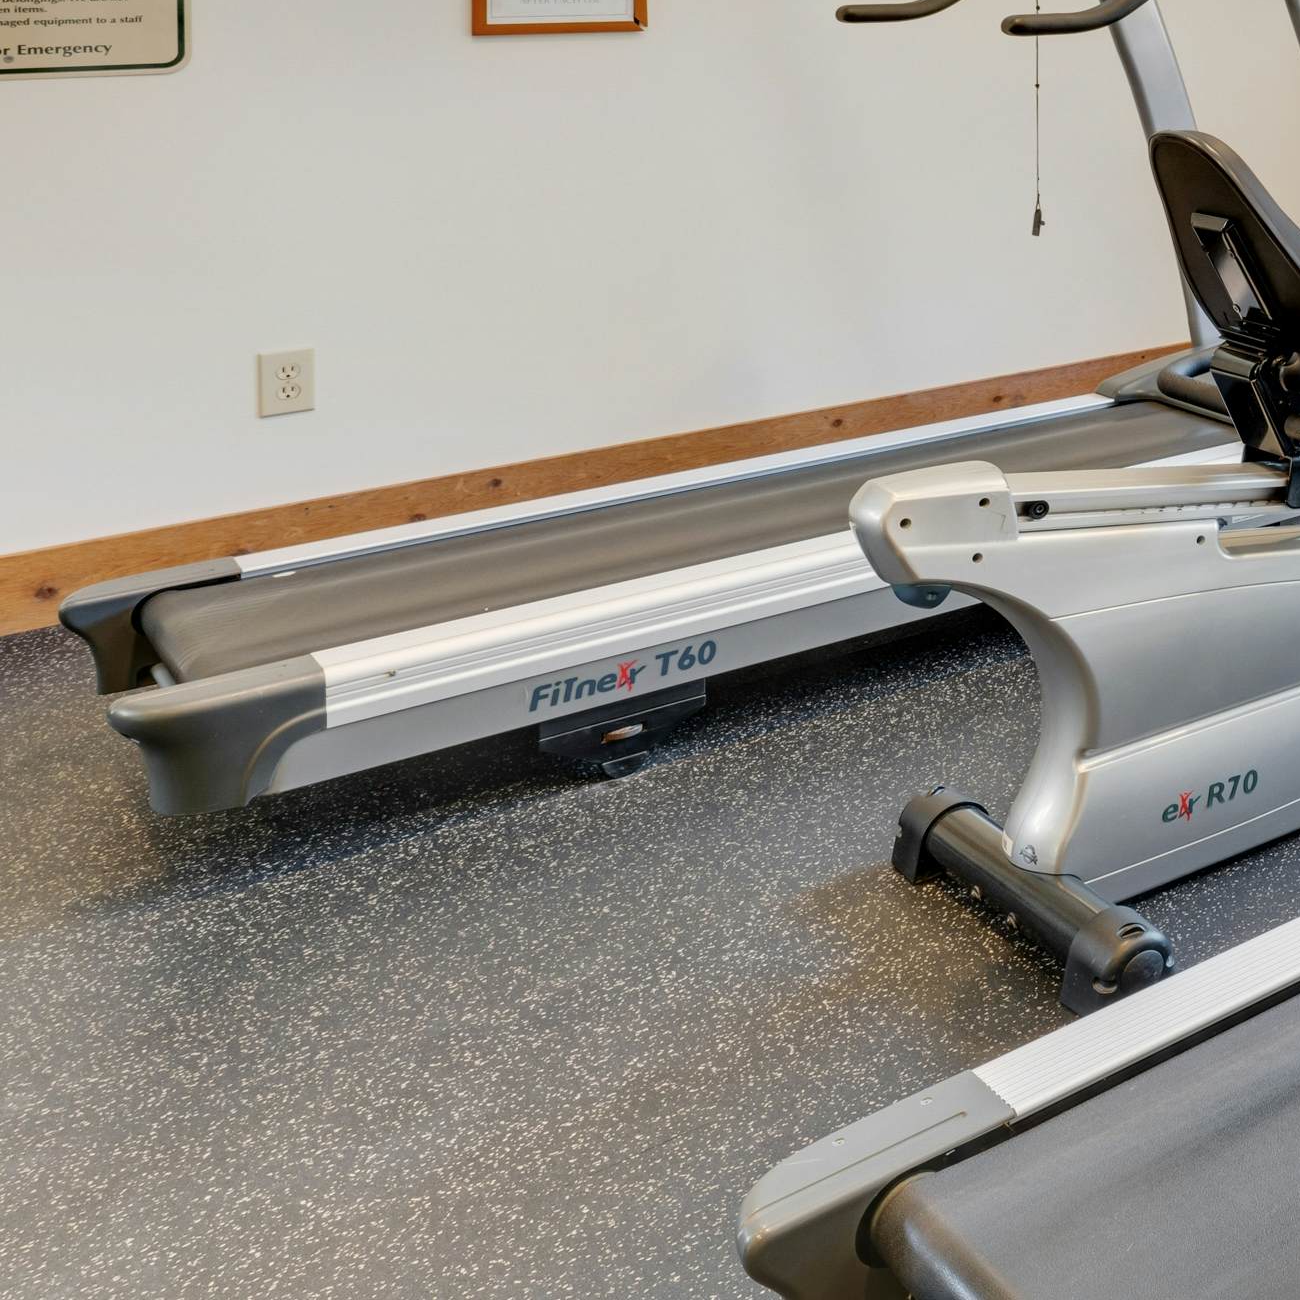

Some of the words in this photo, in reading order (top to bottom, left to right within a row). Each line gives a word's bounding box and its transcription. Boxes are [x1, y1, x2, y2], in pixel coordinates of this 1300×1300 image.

[14, 5, 48, 13] items.
[33, 17, 93, 27] equipment
[96, 16, 107, 24] to
[119, 15, 144, 23] staff
[17, 44, 113, 58] Emergency
[655, 640, 717, 677] T60
[1206, 769, 1258, 809] R70
